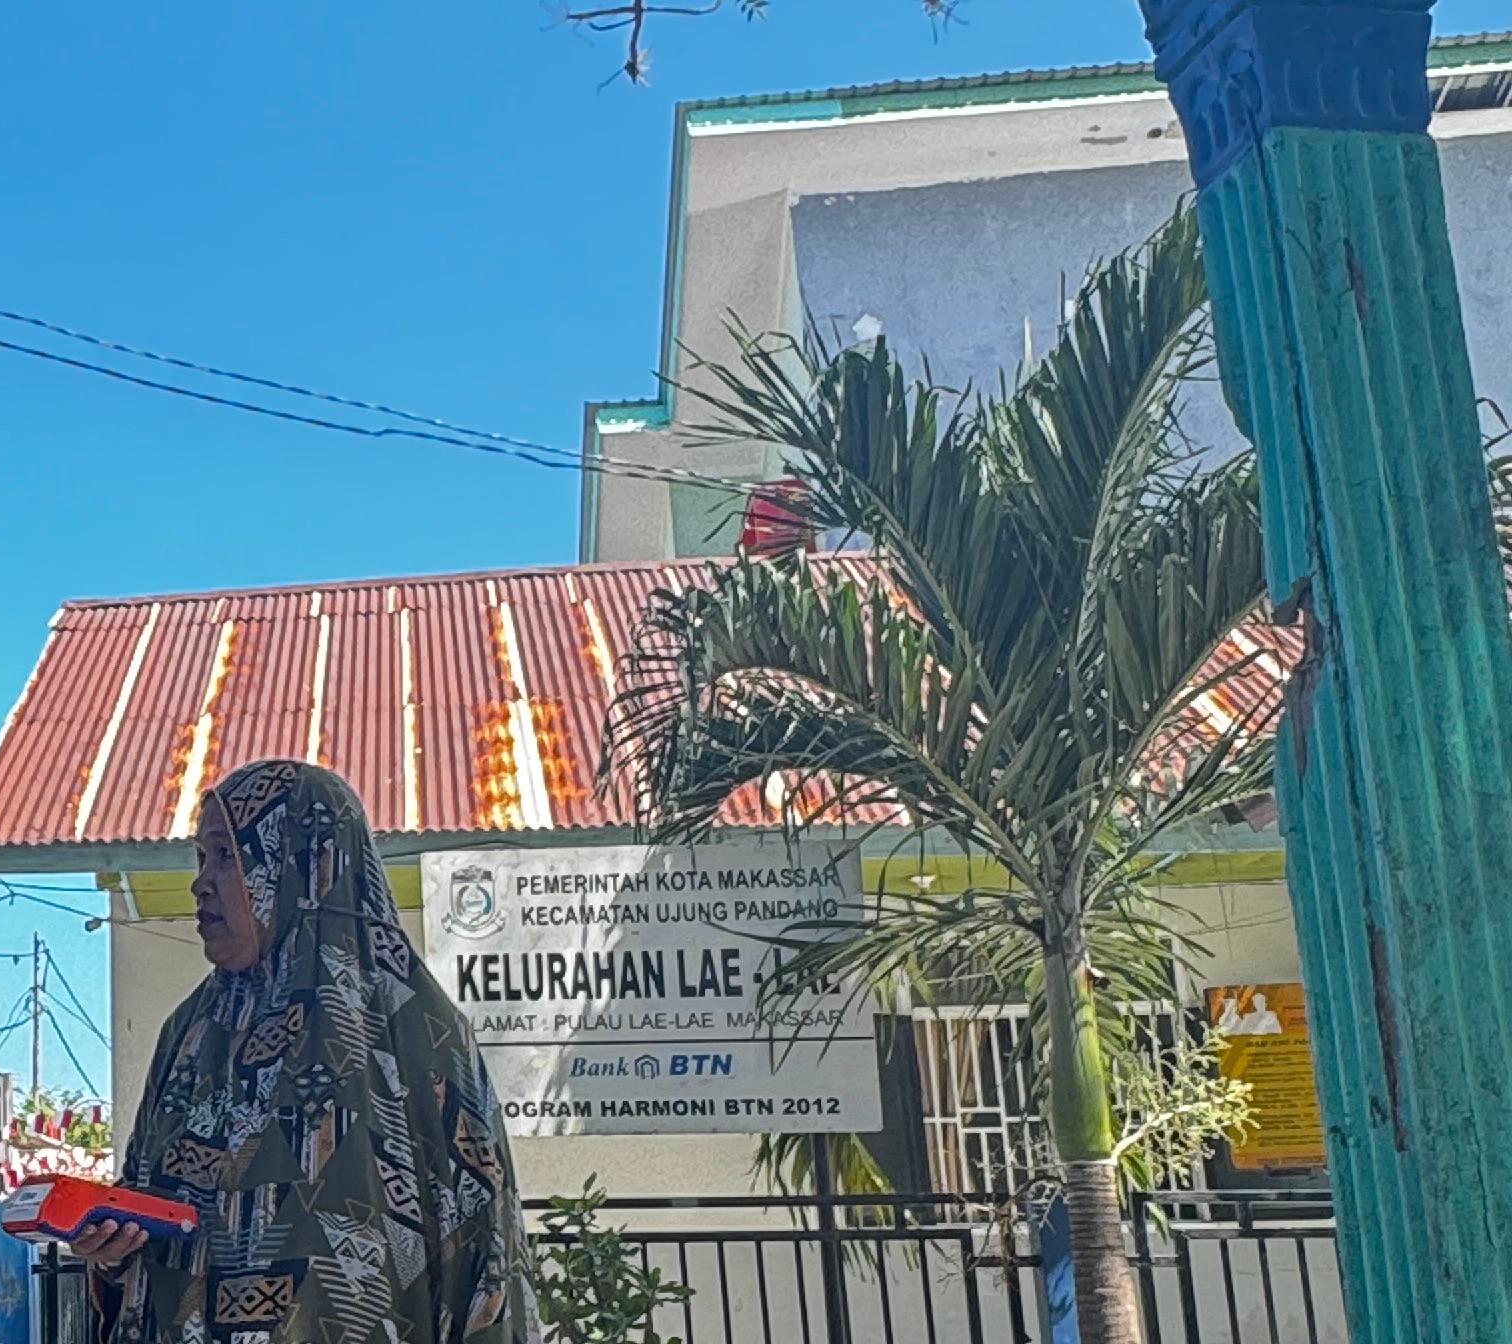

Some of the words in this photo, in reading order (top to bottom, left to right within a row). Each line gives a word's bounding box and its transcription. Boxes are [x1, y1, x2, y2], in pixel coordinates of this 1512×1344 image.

[516, 872, 650, 896] PEMERINTAH
[656, 870, 713, 892] KOTA
[717, 866, 840, 890] MAKASSAR
[520, 902, 650, 926] KECAMATAN
[656, 900, 728, 923] UJUNG
[734, 897, 838, 921] PANDANG
[456, 949, 665, 1002] KELURAHAN
[677, 947, 743, 998] LAE
[470, 1014, 537, 1032] LAMAT
[554, 1012, 622, 1032] PULAU
[629, 1011, 715, 1031] LAE-LAE
[725, 1009, 844, 1028] MAKASSAR
[569, 1056, 630, 1078] Bank
[669, 1053, 733, 1076] BTN
[499, 1100, 592, 1118] OGRAM
[600, 1099, 716, 1118] HARMONI
[724, 1098, 774, 1116] BTN
[782, 1096, 841, 1115] 2012
